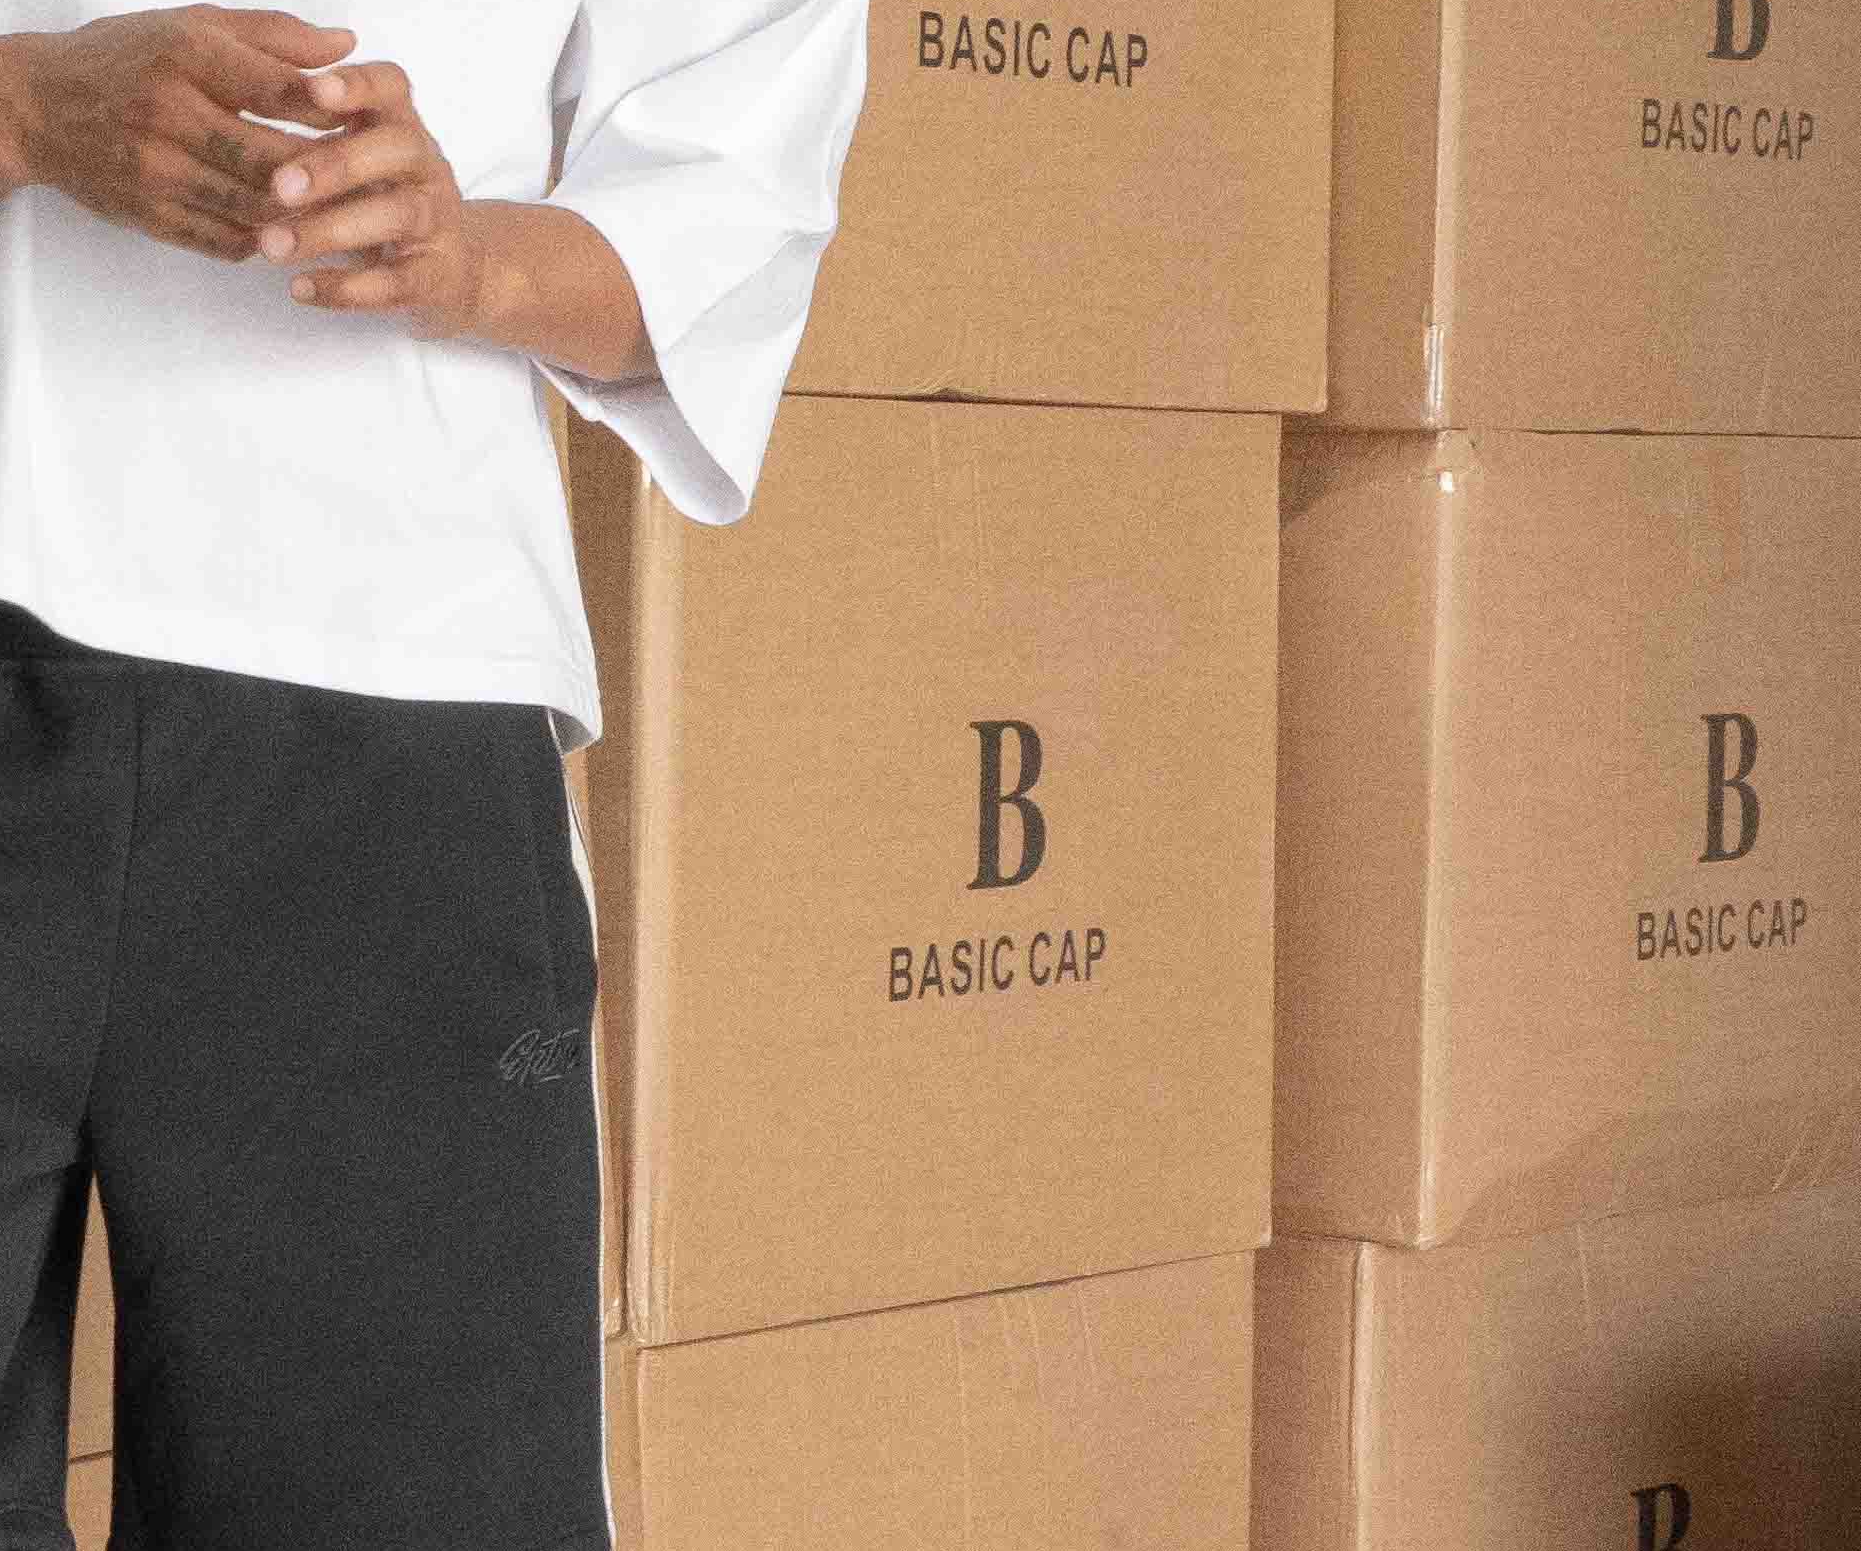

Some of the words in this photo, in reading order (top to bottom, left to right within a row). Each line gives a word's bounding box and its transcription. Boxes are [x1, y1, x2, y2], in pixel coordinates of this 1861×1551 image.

[918, 10, 1052, 79] BASIC
[1066, 26, 1149, 88] CAP
[1640, 98, 1742, 155] BASIC
[1752, 108, 1815, 161] CAP
[966, 720, 1046, 891] B
[1698, 712, 1762, 864] B
[889, 934, 1015, 1003] BASIC
[1029, 927, 1107, 986] CAP
[1635, 903, 1738, 962] BASIC
[1747, 896, 1808, 950] CAP
